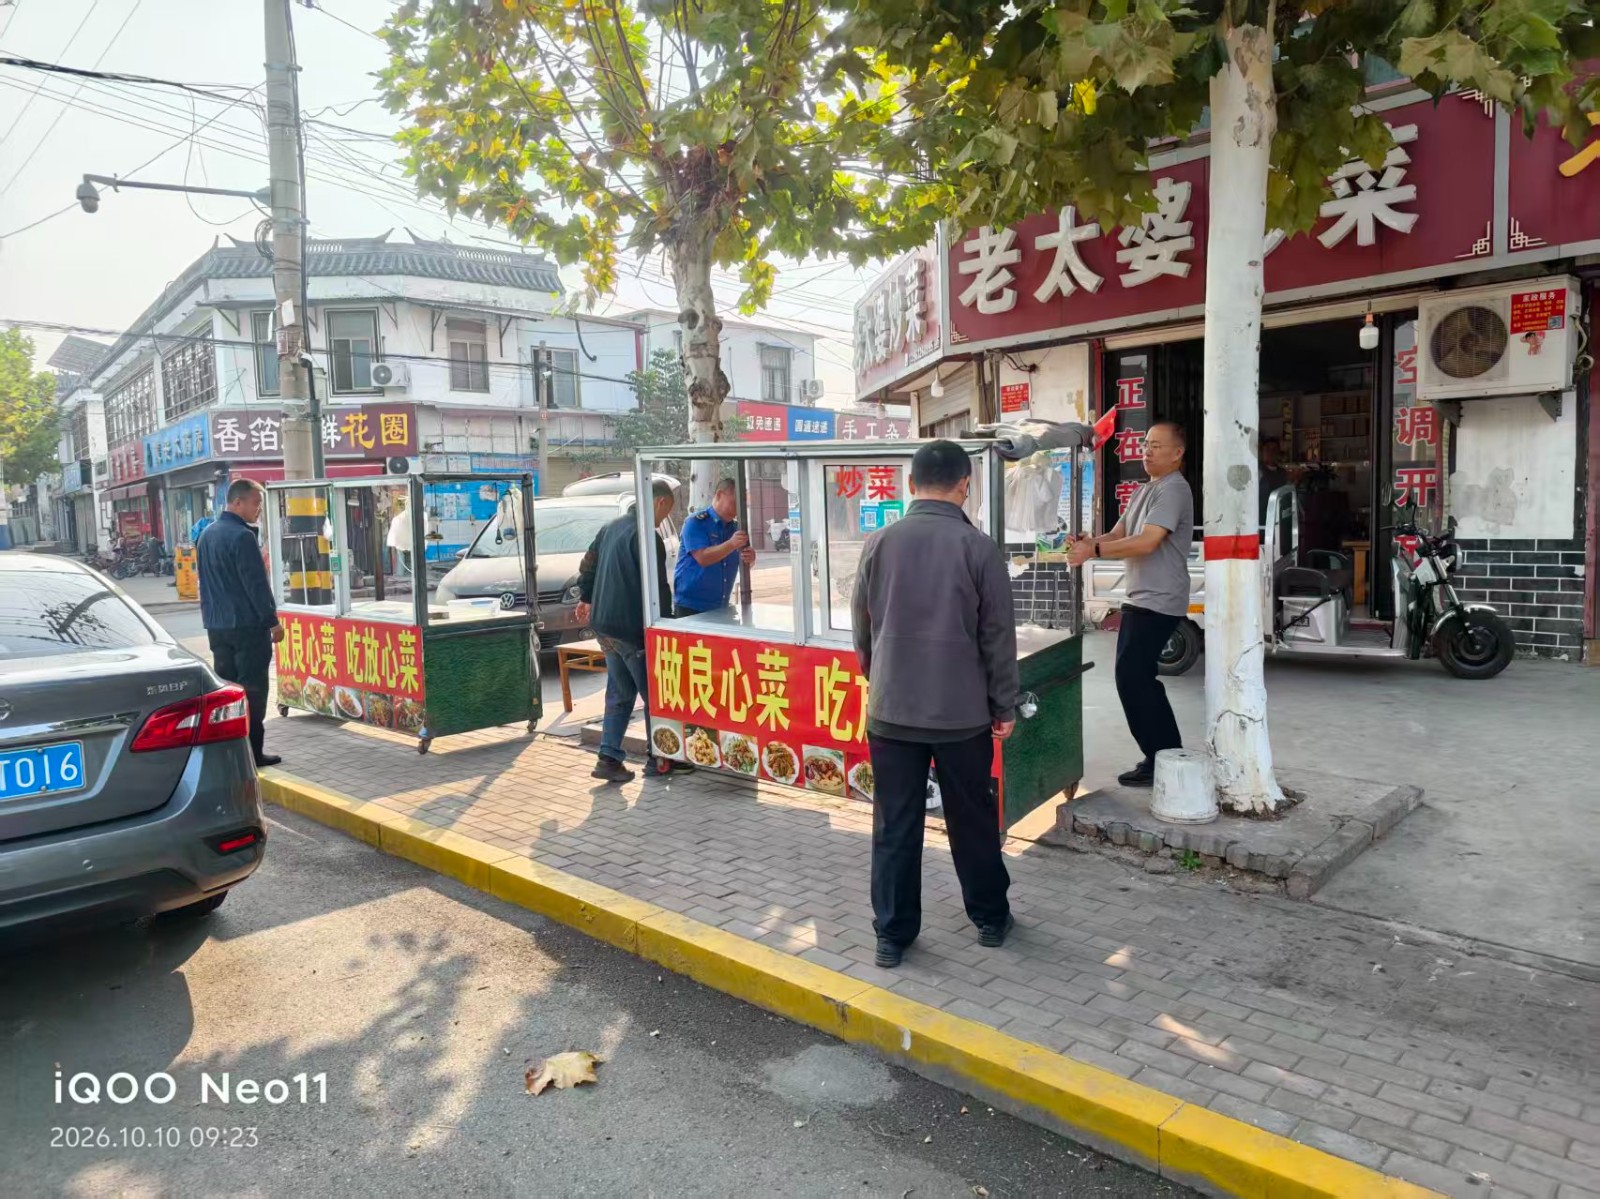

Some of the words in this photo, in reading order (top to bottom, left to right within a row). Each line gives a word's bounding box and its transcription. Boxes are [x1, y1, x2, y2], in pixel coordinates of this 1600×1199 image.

[957, 122, 1420, 314] 老太婆菜
[213, 413, 408, 457] 香箔鲜花圈
[794, 419, 828, 434] 圆通速递
[836, 465, 897, 500] 炒菜
[345, 625, 419, 694] 吃放心菜
[654, 634, 791, 733] 做良心菜
